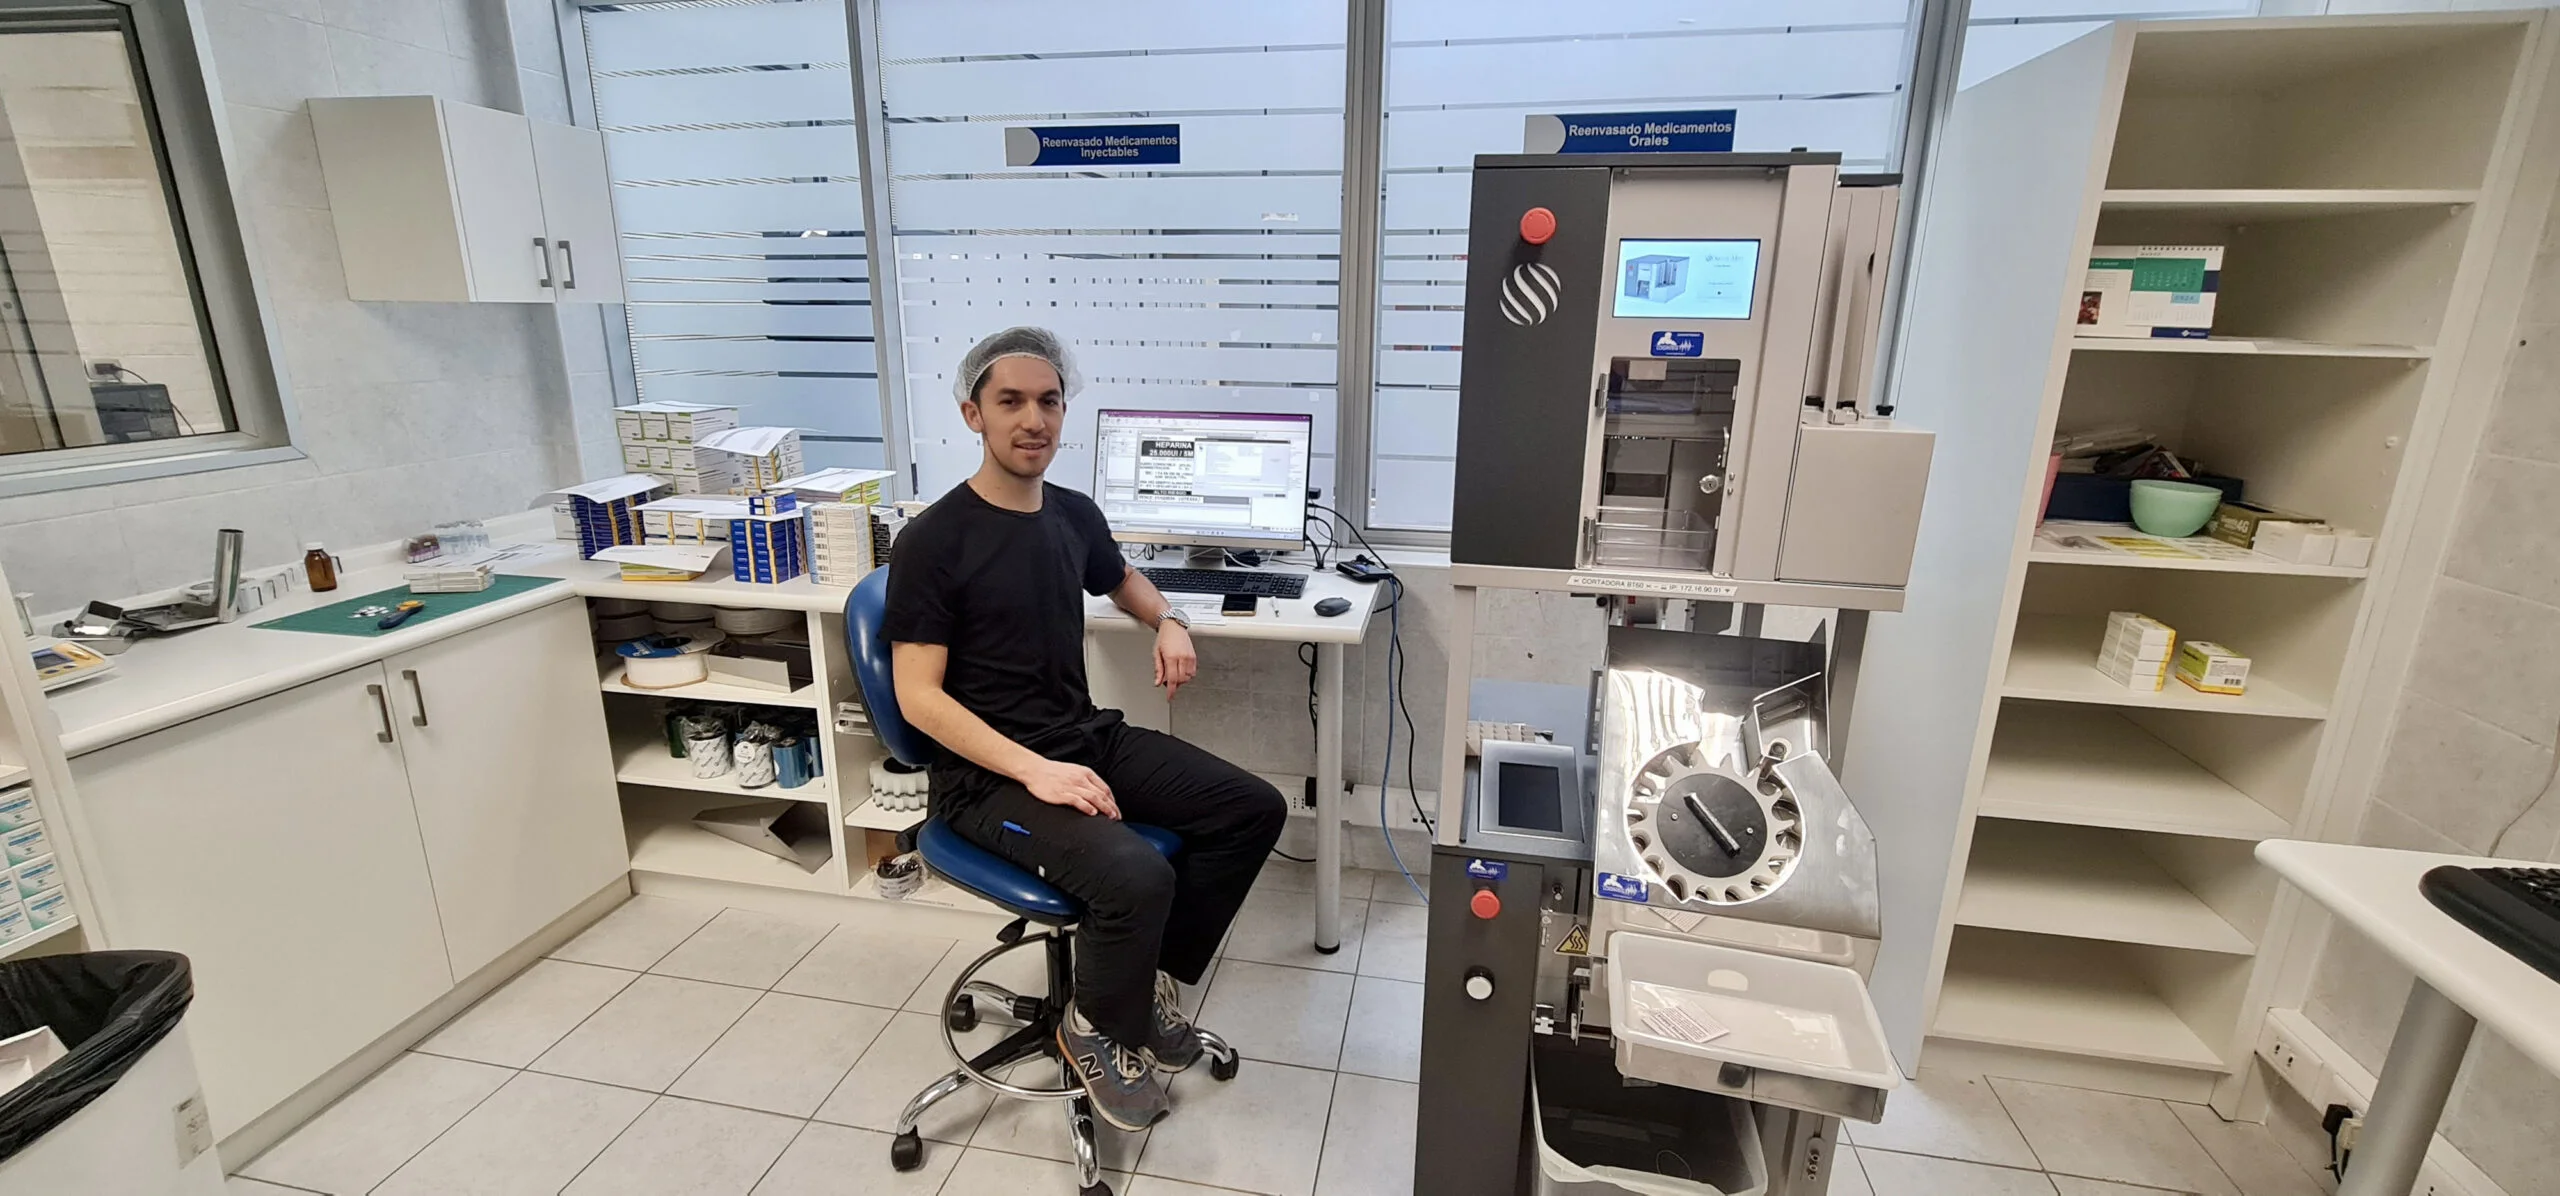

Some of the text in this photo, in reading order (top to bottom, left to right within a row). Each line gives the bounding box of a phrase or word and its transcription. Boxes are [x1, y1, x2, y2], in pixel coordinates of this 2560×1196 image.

[1569, 121, 1732, 136] Reenvasado Medicamentos
[1042, 135, 1178, 148] Reenvasado Medicamentos
[1629, 135, 1669, 147] Orales
[1081, 147, 1139, 159] Inyectables
[1155, 441, 1192, 449] HEPARINA
[1581, 578, 1625, 587] CORTADORA
[1077, 1052, 1105, 1083] N
